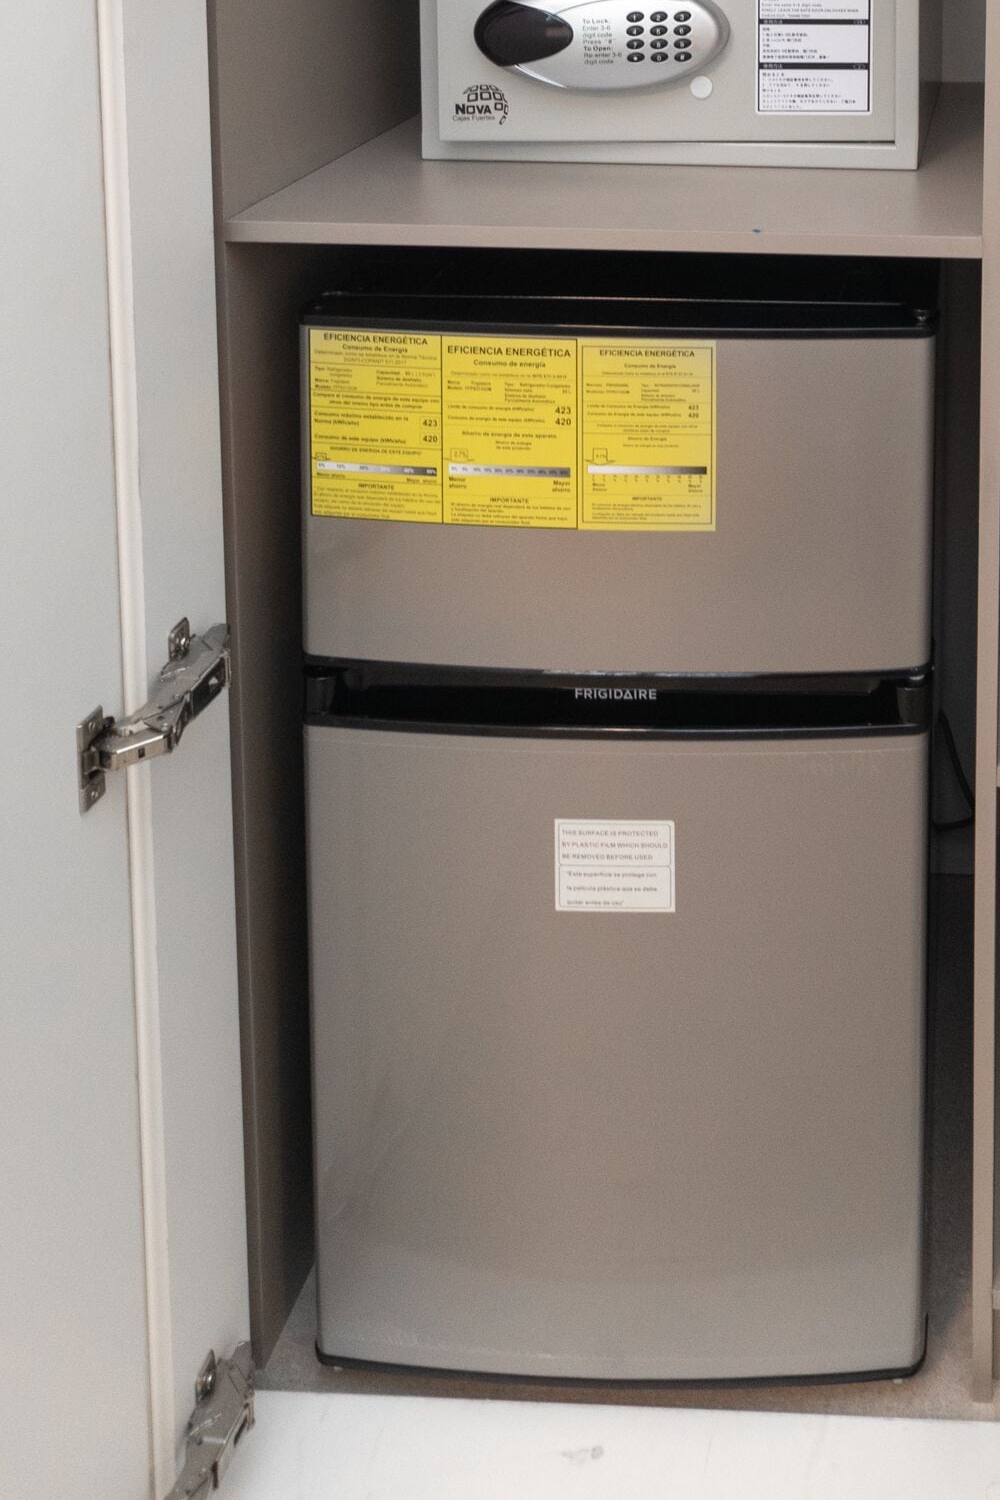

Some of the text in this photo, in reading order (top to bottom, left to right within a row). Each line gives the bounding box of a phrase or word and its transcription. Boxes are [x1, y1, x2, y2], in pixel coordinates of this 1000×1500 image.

[455, 103, 492, 115] NOVA
[324, 333, 428, 346] EFICIENCIA ENERGÉTICA
[342, 344, 374, 352] Consumo
[447, 345, 503, 356] EFICIENCIA
[506, 346, 571, 358] ENERGÉTICA
[600, 349, 695, 358] EFICIENCIA ENERGÉTICA
[473, 359, 508, 367] Consumo
[555, 406, 572, 414] 423
[422, 419, 438, 428] 423
[555, 418, 572, 426] 420
[422, 435, 438, 443] 420
[574, 687, 657, 700] FRIGIDAIRE
